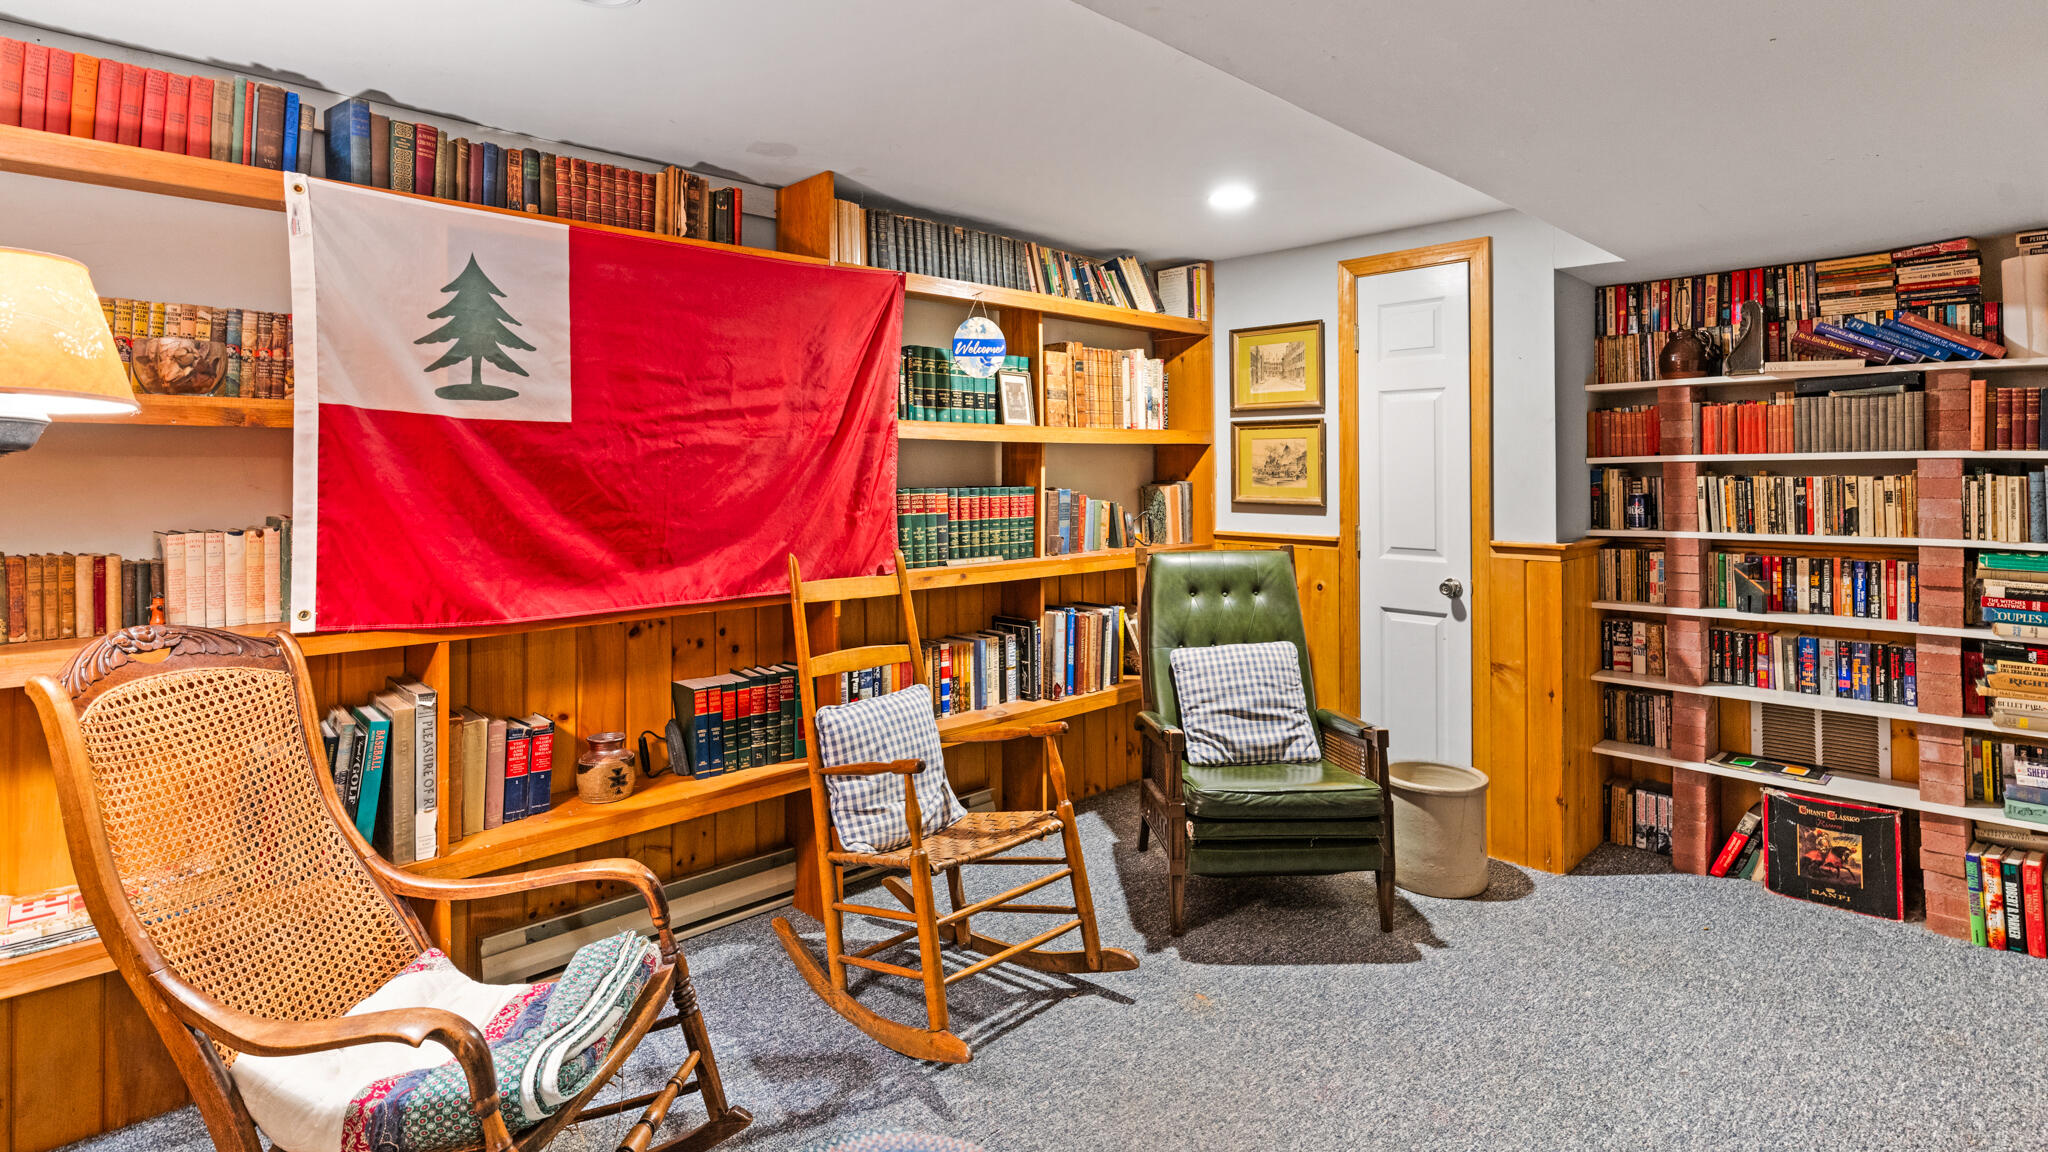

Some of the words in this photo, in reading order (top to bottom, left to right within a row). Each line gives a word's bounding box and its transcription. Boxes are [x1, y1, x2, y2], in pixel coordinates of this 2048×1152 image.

[954, 340, 1005, 355] Welcome
[2000, 598, 2026, 606] WITCHES
[371, 730, 386, 771] BASEBALL
[422, 720, 434, 776] PLEASURE
[349, 762, 360, 805] GOLF
[423, 778, 435, 793] OF
[1798, 805, 1827, 817] CHIANTI
[1827, 810, 1860, 822] CLASSICO
[1811, 889, 1851, 902] BANFI
[2005, 881, 2019, 906] ROBERT
[2008, 914, 2021, 939] PARKER
